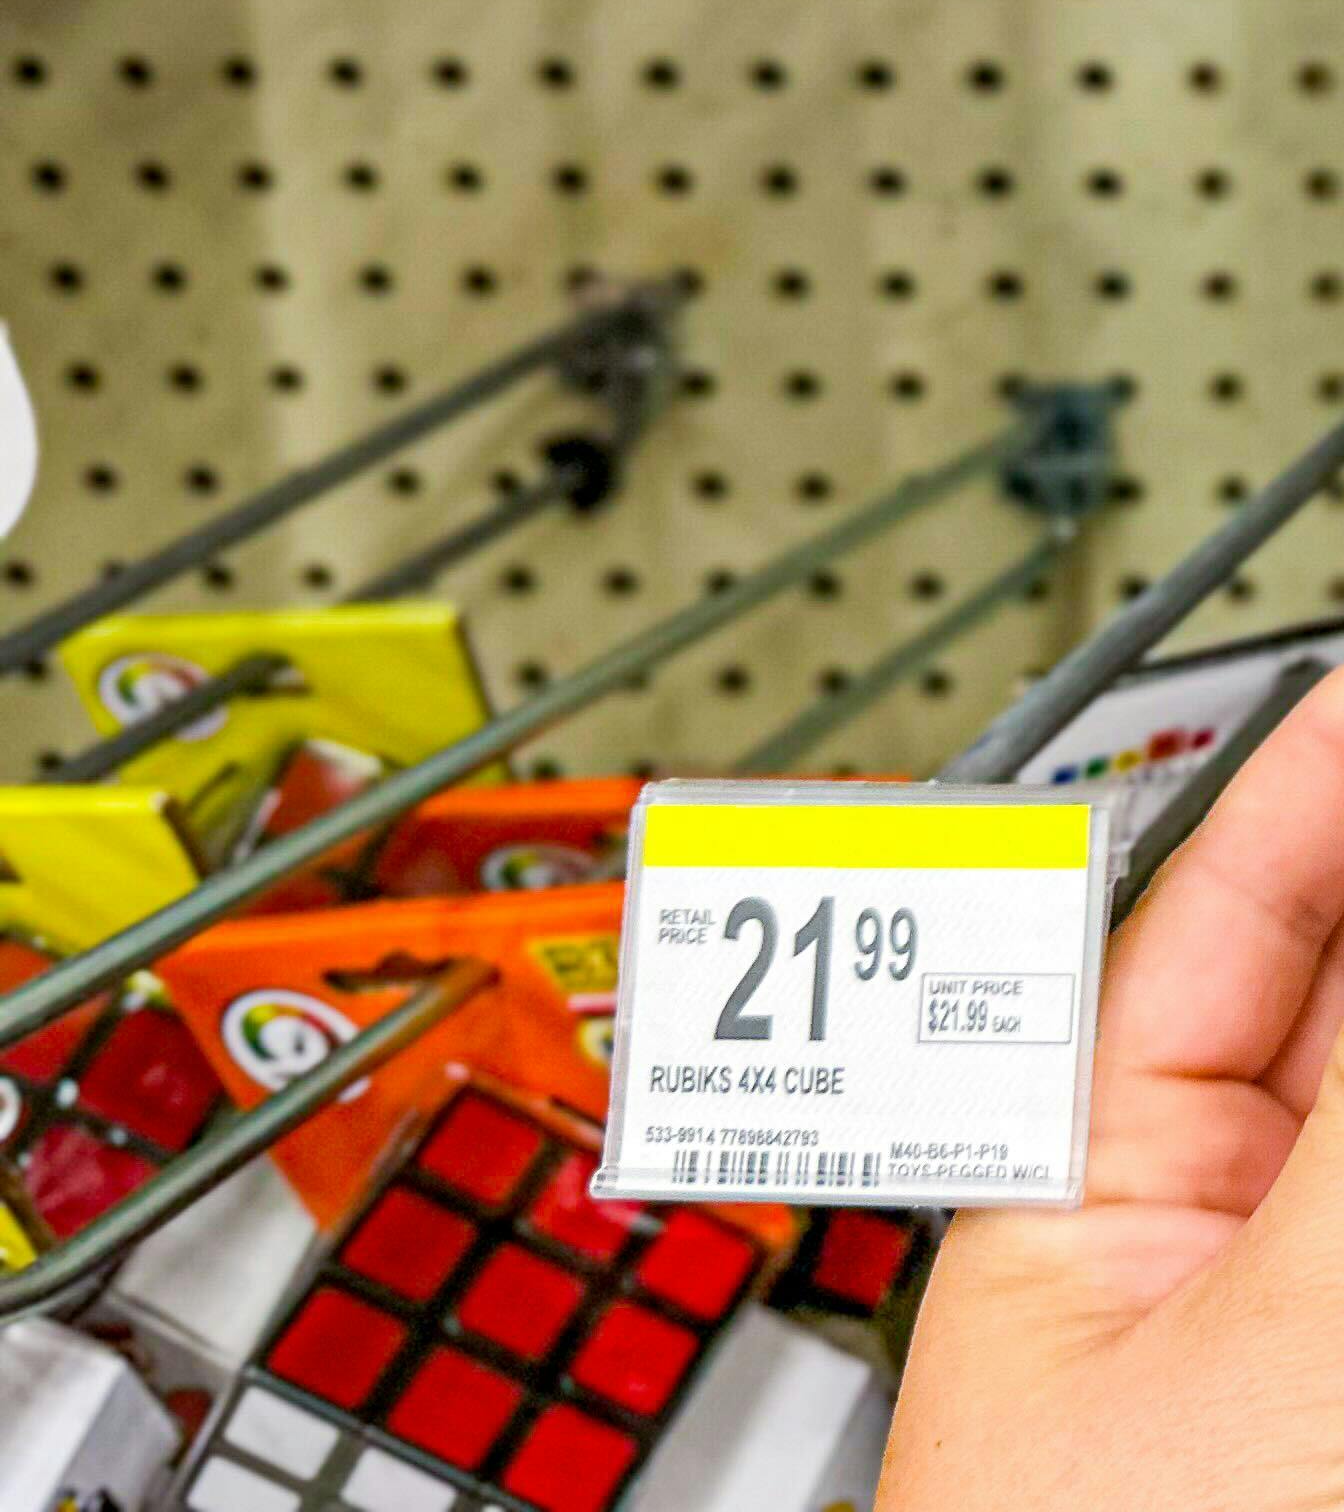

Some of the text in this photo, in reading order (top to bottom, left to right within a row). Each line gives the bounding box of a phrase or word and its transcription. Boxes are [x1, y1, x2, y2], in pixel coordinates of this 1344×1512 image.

[658, 909, 716, 927] RETAIL
[657, 927, 709, 945] PRICE
[928, 980, 1024, 996] UNIT PRICE
[927, 999, 990, 1035] $21.99
[650, 1066, 846, 1096] RUBIKS 4X4 CUBE
